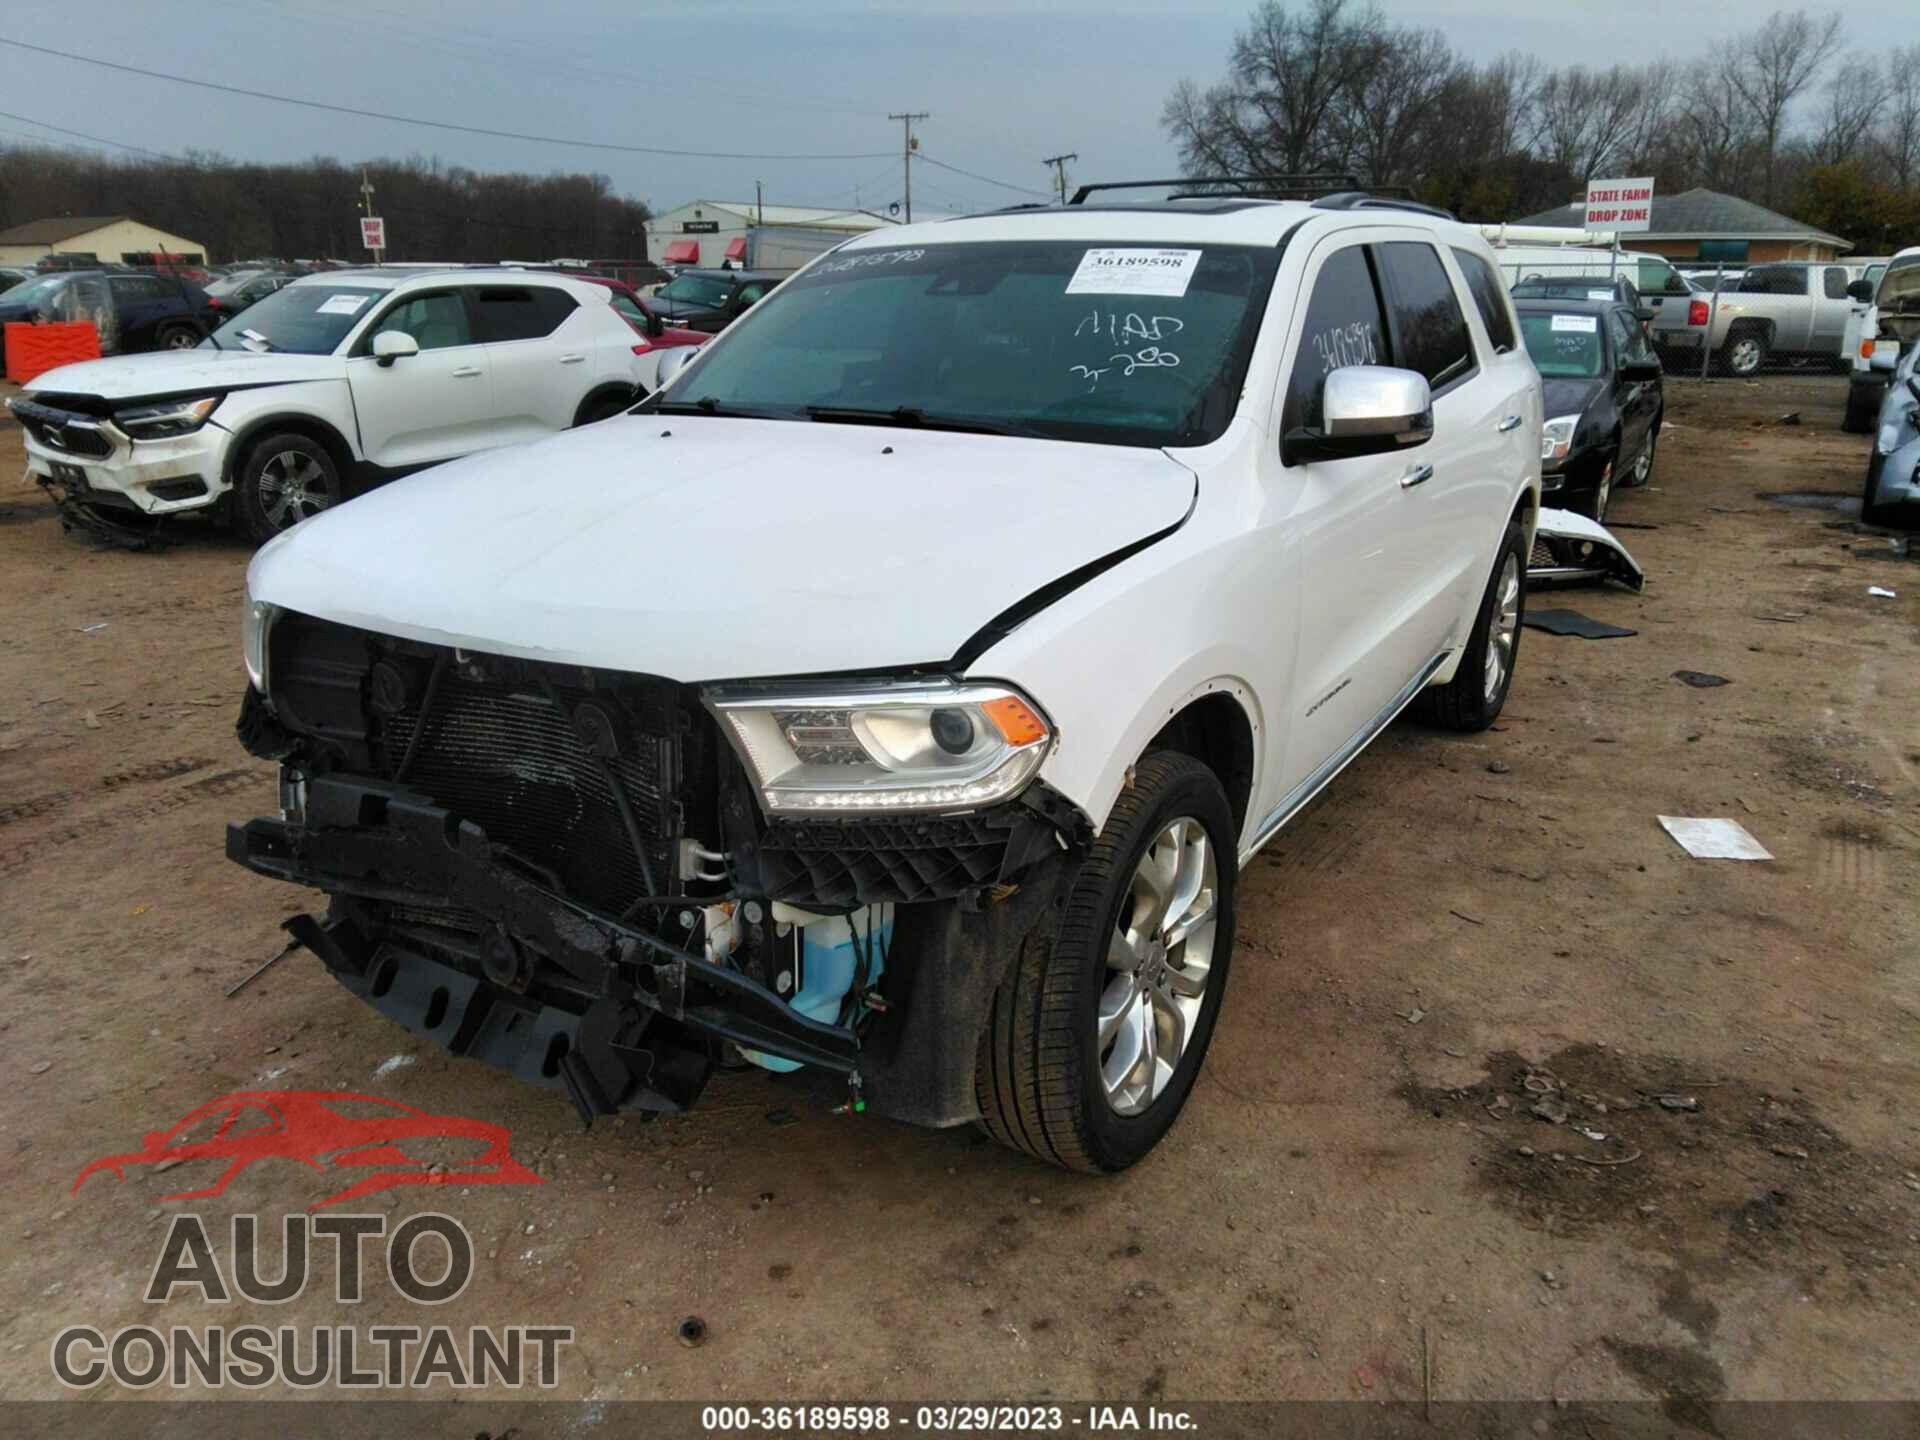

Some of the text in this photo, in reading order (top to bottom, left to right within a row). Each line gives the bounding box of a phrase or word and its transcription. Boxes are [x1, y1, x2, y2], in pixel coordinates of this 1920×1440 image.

[1590, 187, 1650, 203] STATE FARM
[1588, 208, 1649, 223] DROP ZONE
[1096, 256, 1184, 268] 36189598
